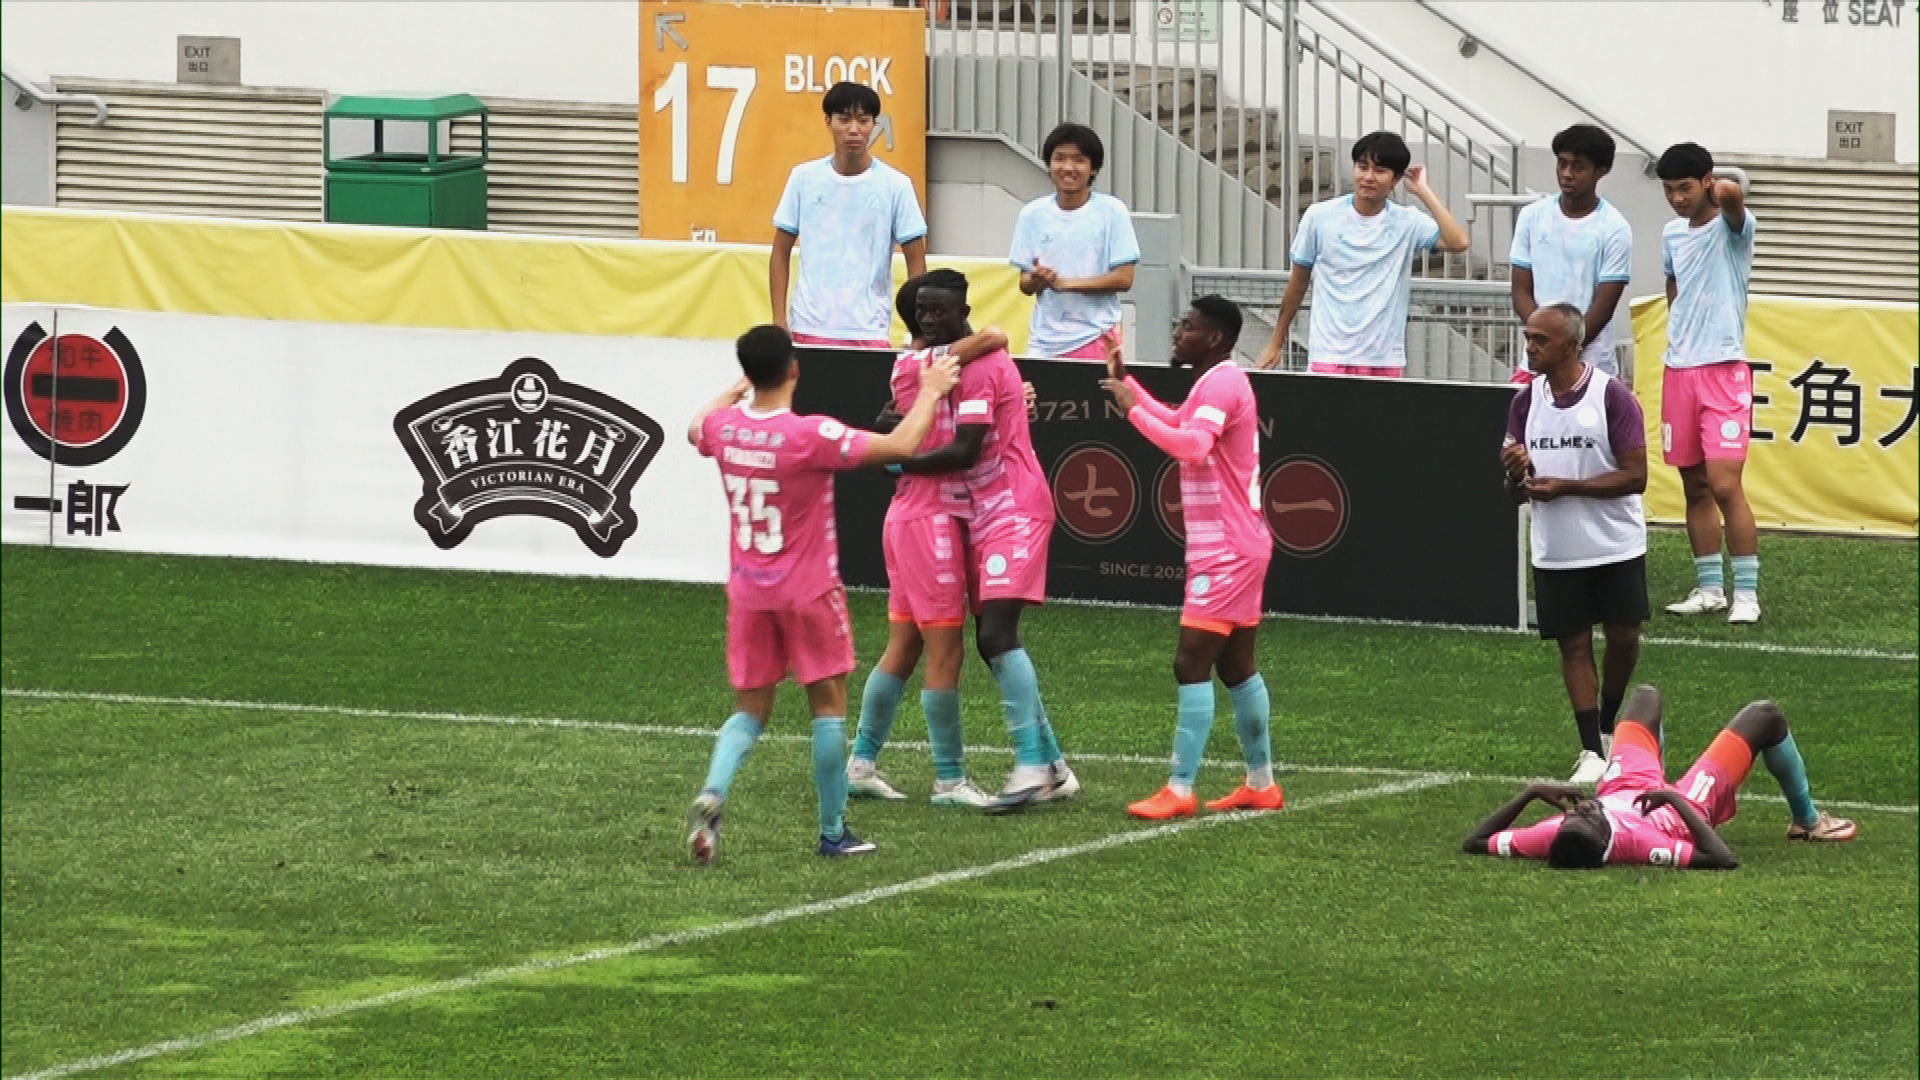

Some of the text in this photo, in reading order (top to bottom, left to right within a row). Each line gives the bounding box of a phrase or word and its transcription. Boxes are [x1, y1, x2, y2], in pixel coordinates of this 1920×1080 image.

[1848, 0, 1905, 27] SEAT
[184, 46, 211, 58] EXIT
[188, 61, 208, 72] 出口
[784, 54, 893, 95] BLOCK
[654, 61, 757, 185] 17
[1835, 121, 1864, 133] EXIT
[1839, 137, 1861, 148] 出口
[441, 417, 616, 475] 香江花月
[1530, 436, 1583, 450] KELME
[470, 471, 585, 494] VICTORIAN ERA
[725, 474, 784, 554] 35
[1100, 561, 1185, 580] SINCE 202
